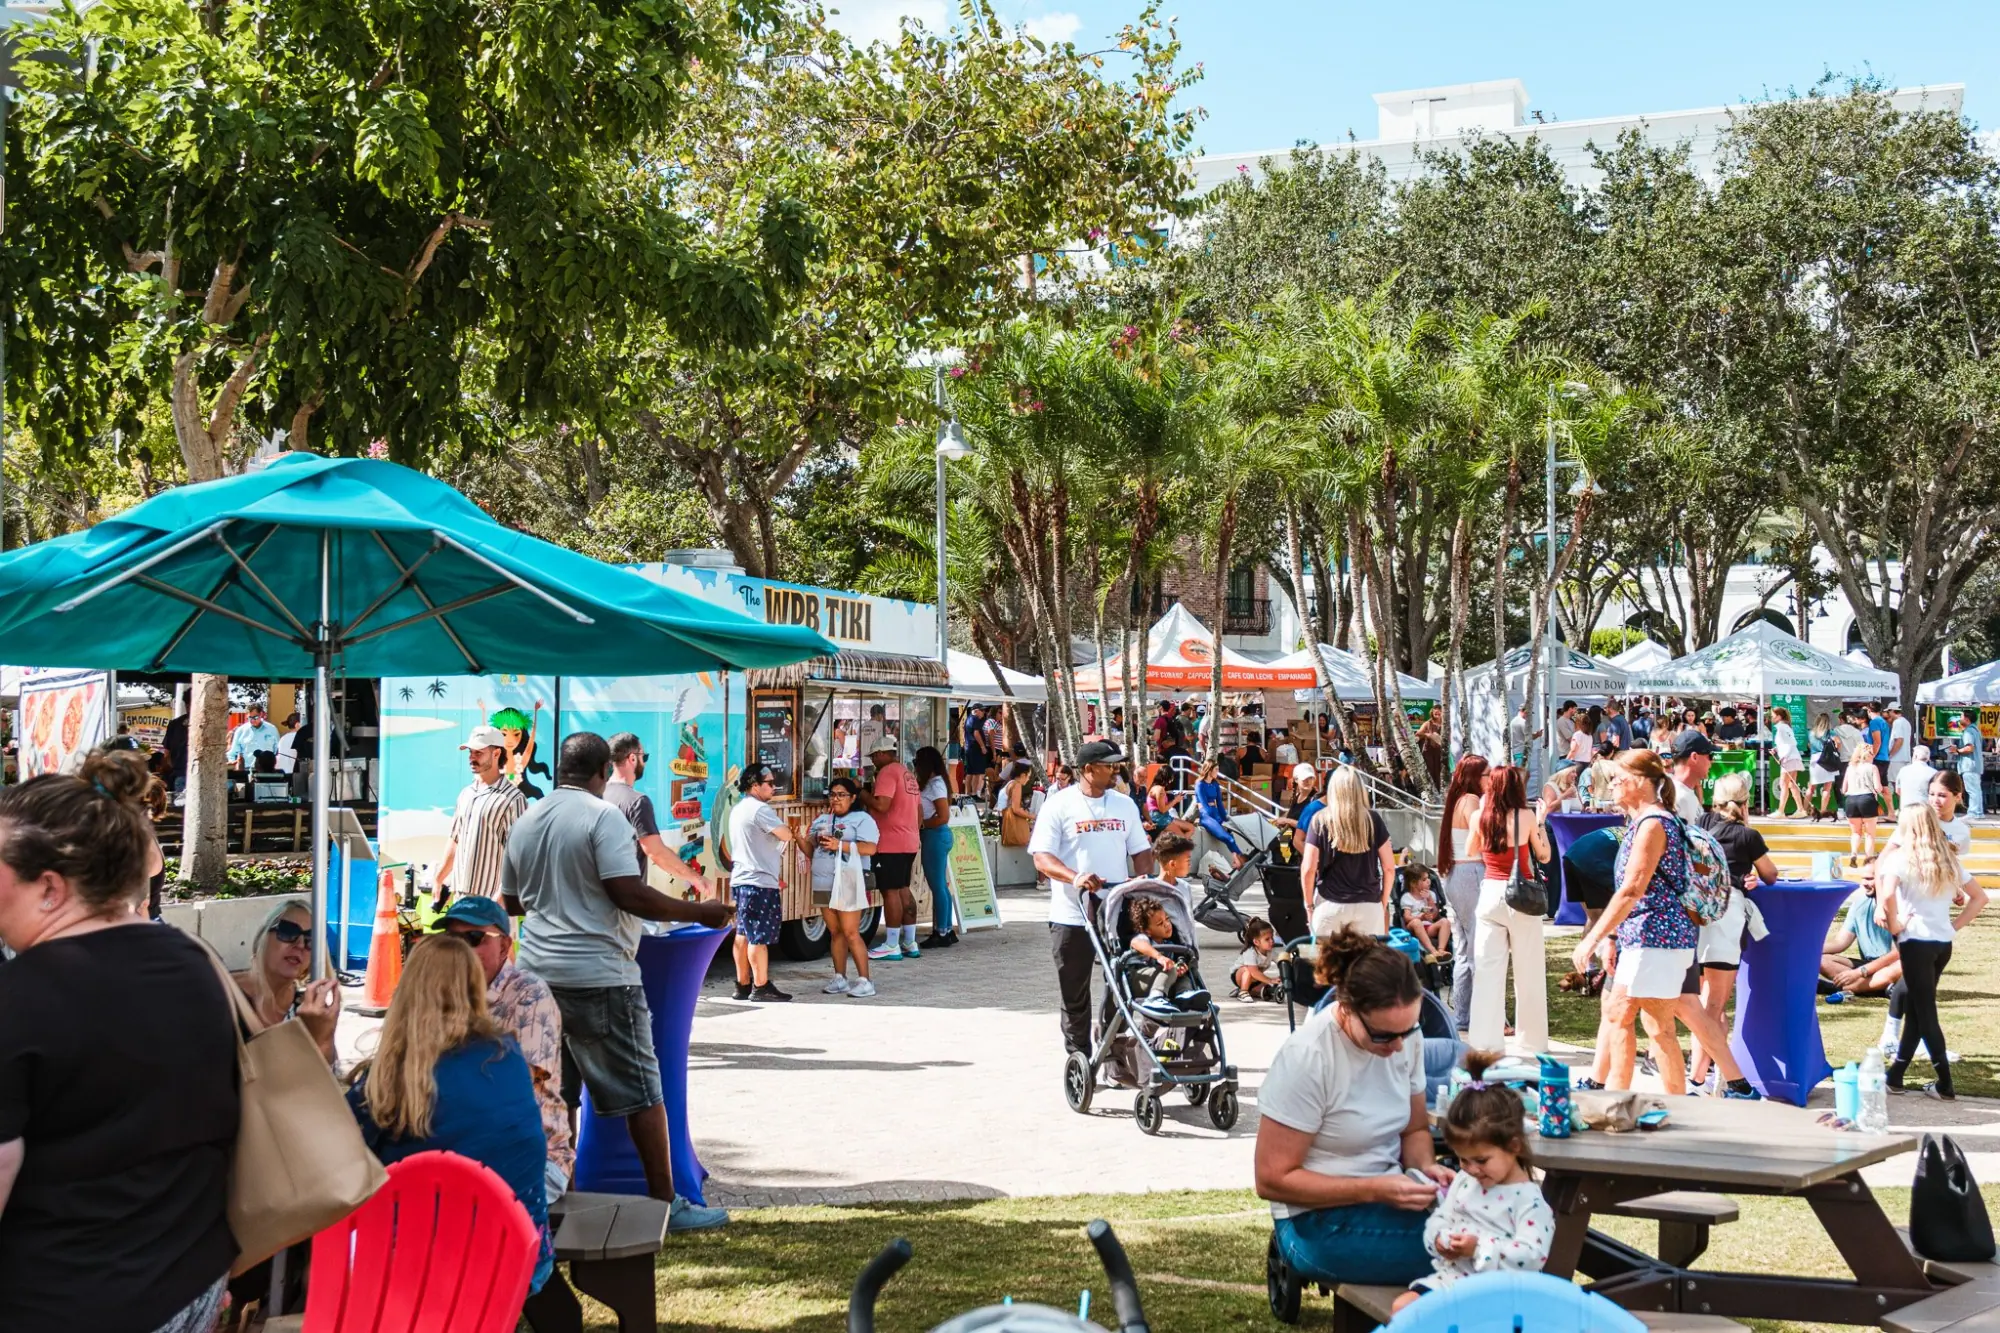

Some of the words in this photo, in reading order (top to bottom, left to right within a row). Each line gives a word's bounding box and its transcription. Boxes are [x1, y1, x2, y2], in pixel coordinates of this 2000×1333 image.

[739, 584, 761, 606] The
[763, 586, 820, 634] WPB
[825, 596, 872, 642] TIKI
[1255, 672, 1274, 681] LECHE
[1604, 680, 1626, 690] BOW
[1653, 679, 1674, 687] BOWLS
[1791, 679, 1813, 687] BOWLS
[1820, 680, 1867, 688] COLD-PRESSED
